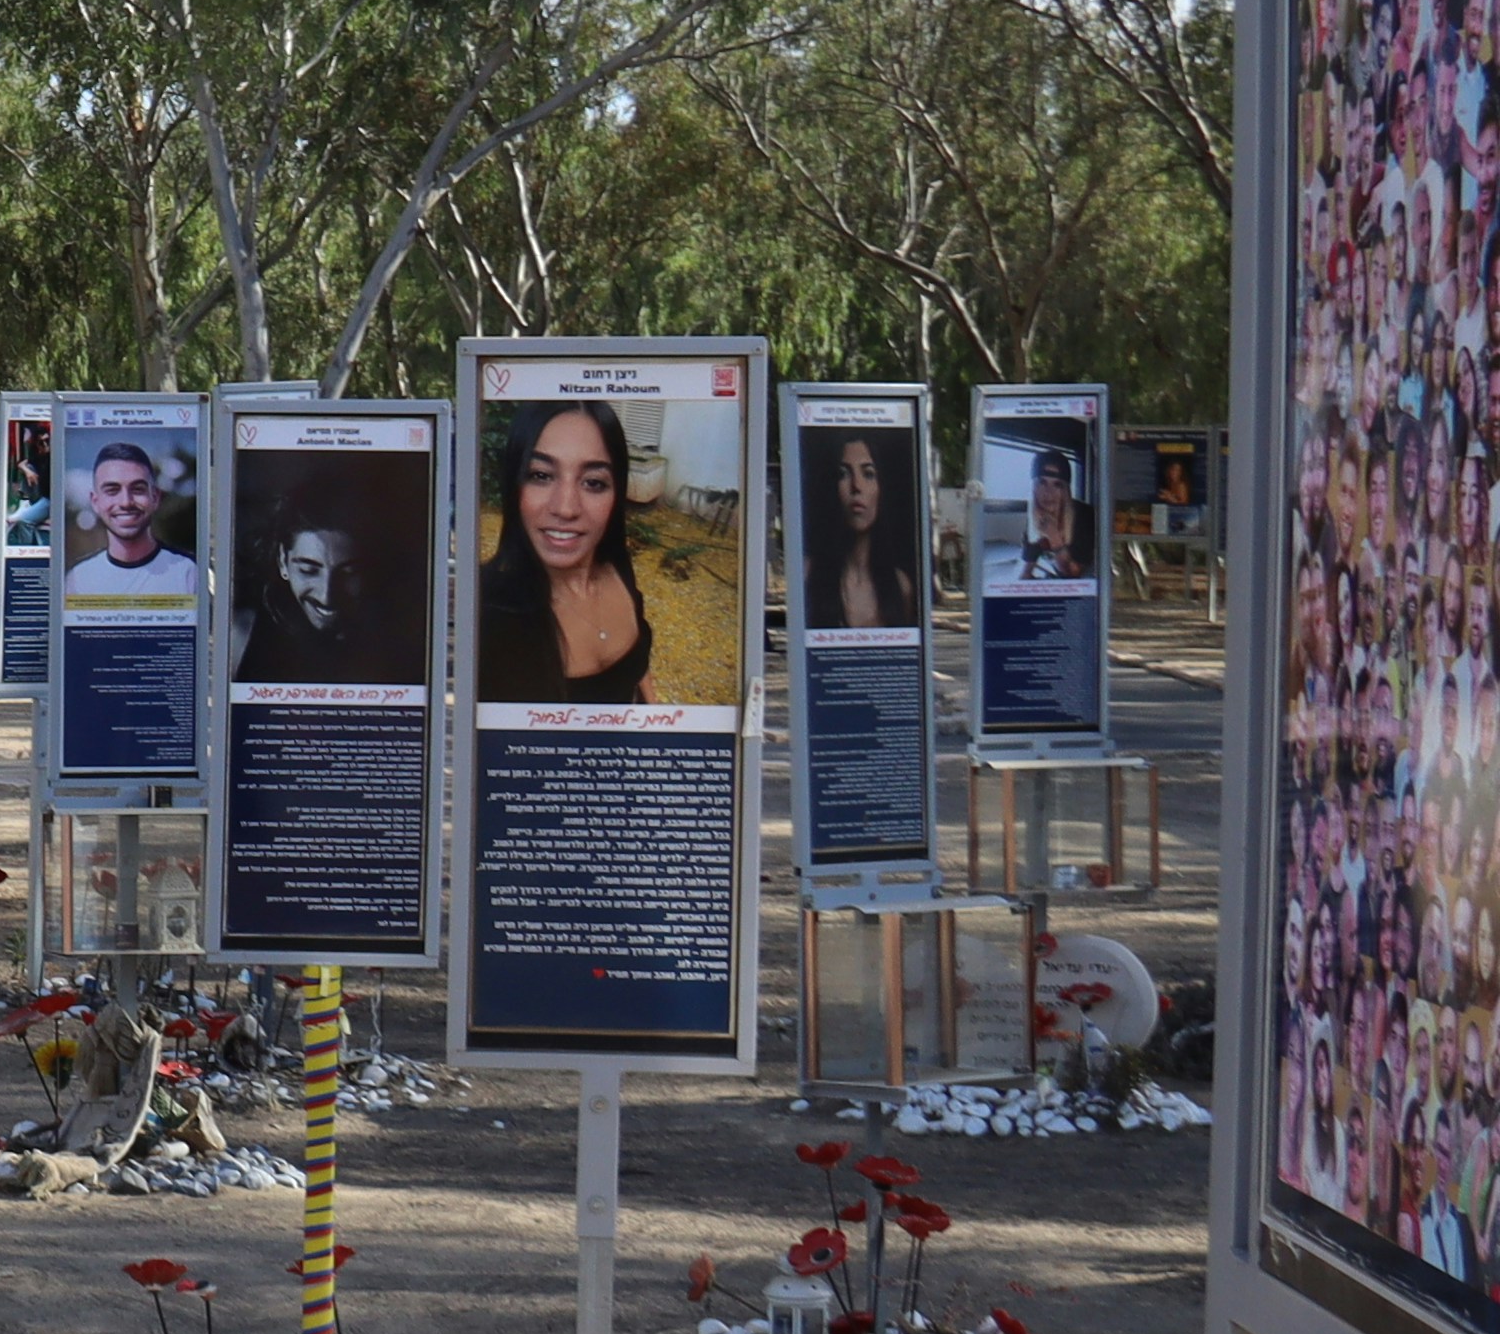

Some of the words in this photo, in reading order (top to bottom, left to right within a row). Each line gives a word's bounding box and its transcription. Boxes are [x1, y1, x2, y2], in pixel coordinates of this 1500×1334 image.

[582, 369, 611, 379] רחום
[614, 369, 637, 381] ניצן
[559, 383, 602, 393] Nitzan
[606, 383, 660, 393] Rahoum
[296, 437, 335, 445] Antonio
[337, 437, 372, 446] Macias
